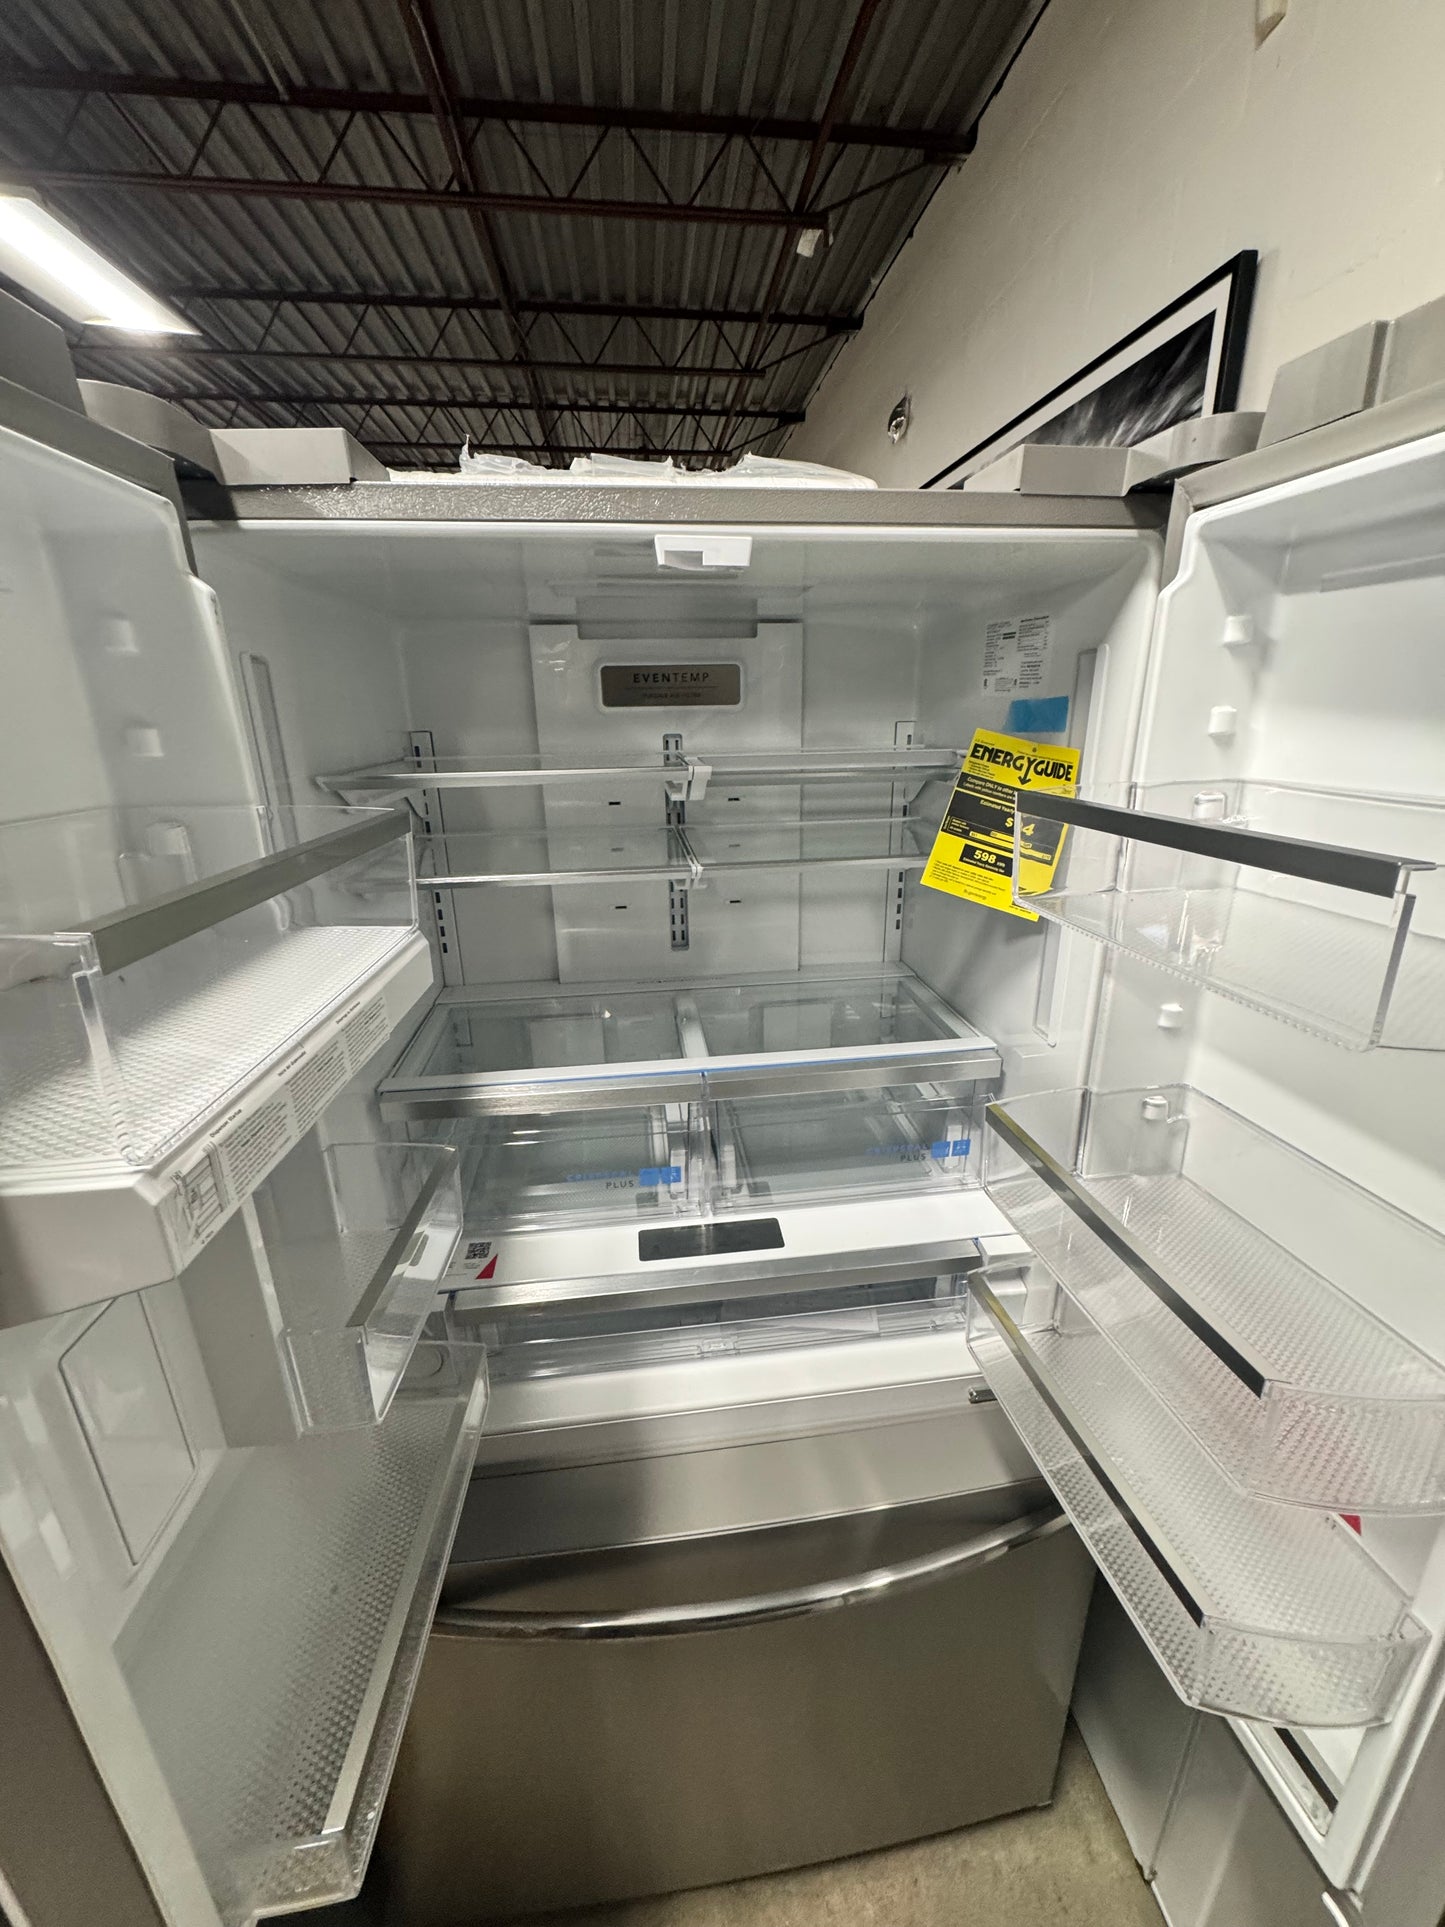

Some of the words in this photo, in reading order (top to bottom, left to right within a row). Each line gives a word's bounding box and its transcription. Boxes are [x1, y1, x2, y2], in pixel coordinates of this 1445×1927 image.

[633, 672, 710, 683] EVENTEMP
[970, 743, 1074, 783] ENERGYGUIDE
[967, 777, 986, 786] Compare
[986, 781, 997, 789] ONLY
[980, 799, 1002, 810] Estimated
[1002, 805, 1015, 815] Yearly
[1005, 817, 1035, 836] $4
[973, 850, 997, 864] 598
[899, 1153, 927, 1162] PLUS
[605, 1180, 635, 1189] PLUS
